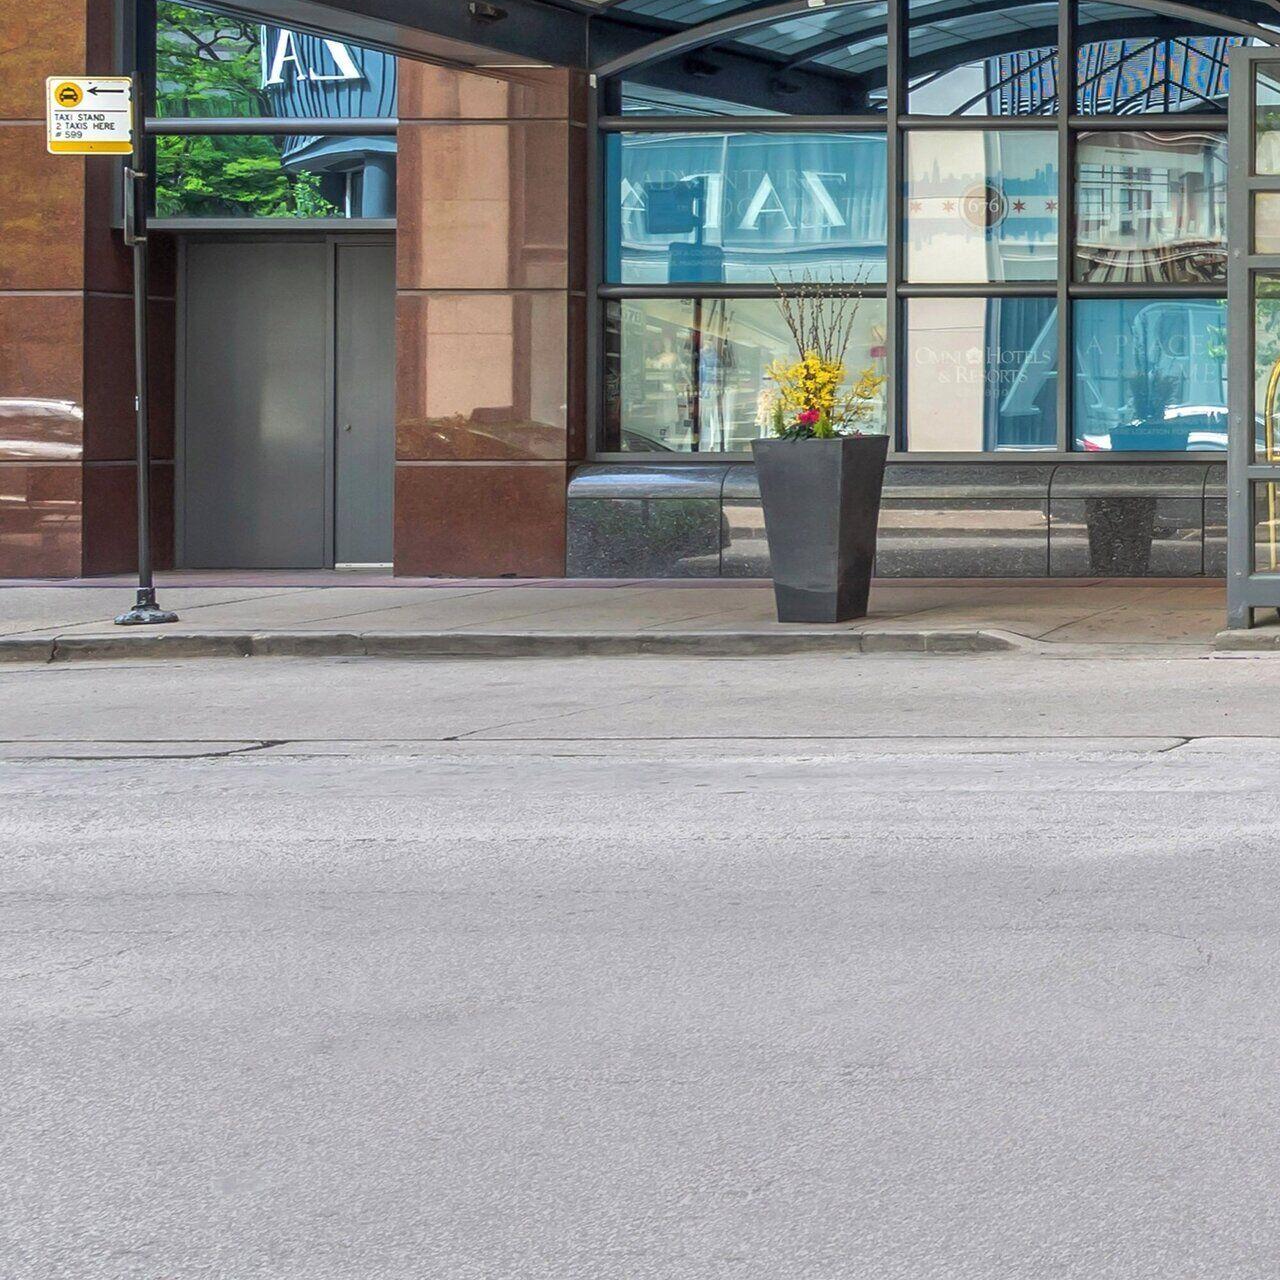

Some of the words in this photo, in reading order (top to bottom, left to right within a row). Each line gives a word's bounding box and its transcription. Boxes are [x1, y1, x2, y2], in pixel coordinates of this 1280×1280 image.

[54, 113, 73, 121] TAXI
[77, 113, 106, 121] STAND
[56, 122, 62, 130] 2
[65, 122, 88, 130] TAXIS
[92, 122, 116, 130] HERE
[64, 130, 83, 138] 599
[914, 346, 962, 366] OMNI
[985, 346, 1052, 365] HOTELS
[955, 365, 1029, 384] RESORTS
